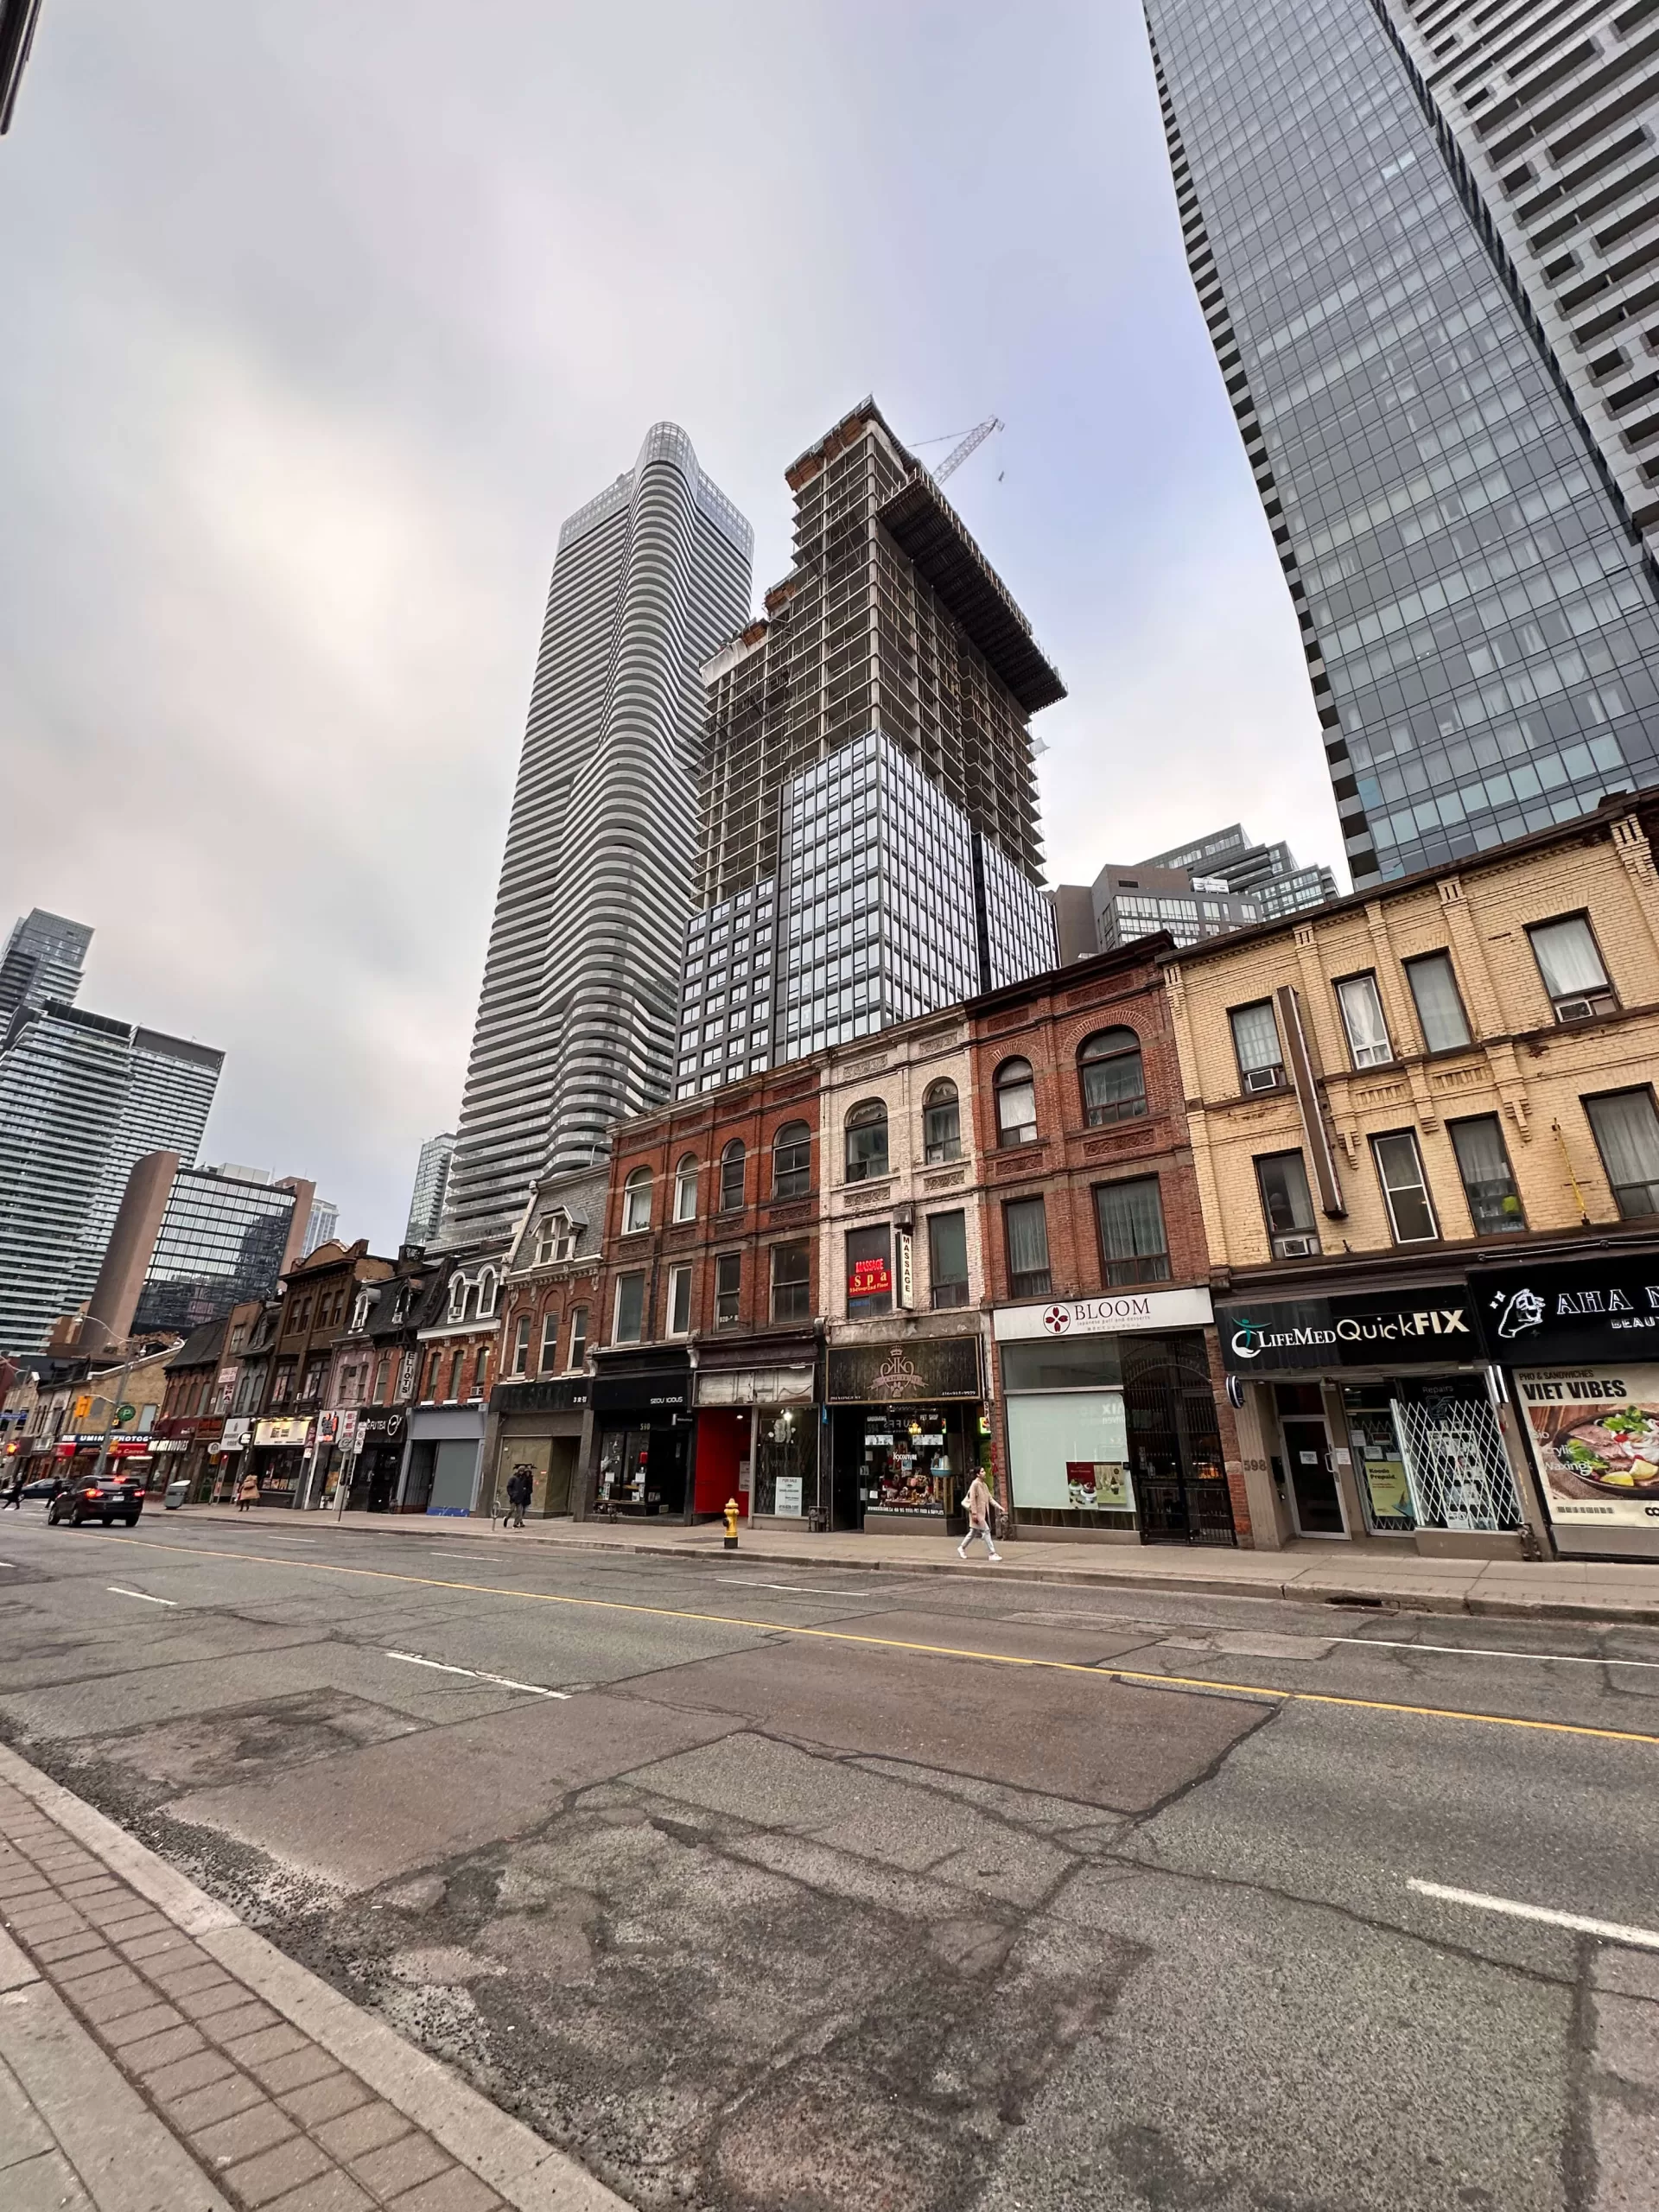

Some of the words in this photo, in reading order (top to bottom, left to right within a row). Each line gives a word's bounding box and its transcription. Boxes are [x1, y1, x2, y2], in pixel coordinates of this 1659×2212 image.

[855, 1258, 884, 1273] MASSAGE
[855, 1272, 887, 1287] Spa
[1074, 1298, 1151, 1320] BLOOM
[1557, 1288, 1634, 1314] AHA
[402, 1352, 416, 1393] ELIOTS
[1543, 1370, 1594, 1380] SANDWICHES
[224, 1384, 233, 1401] SPA
[1422, 1385, 1453, 1394] Repairs
[1522, 1382, 1563, 1400] VIET
[1566, 1380, 1627, 1399] VIBES
[1244, 1459, 1268, 1471] 598
